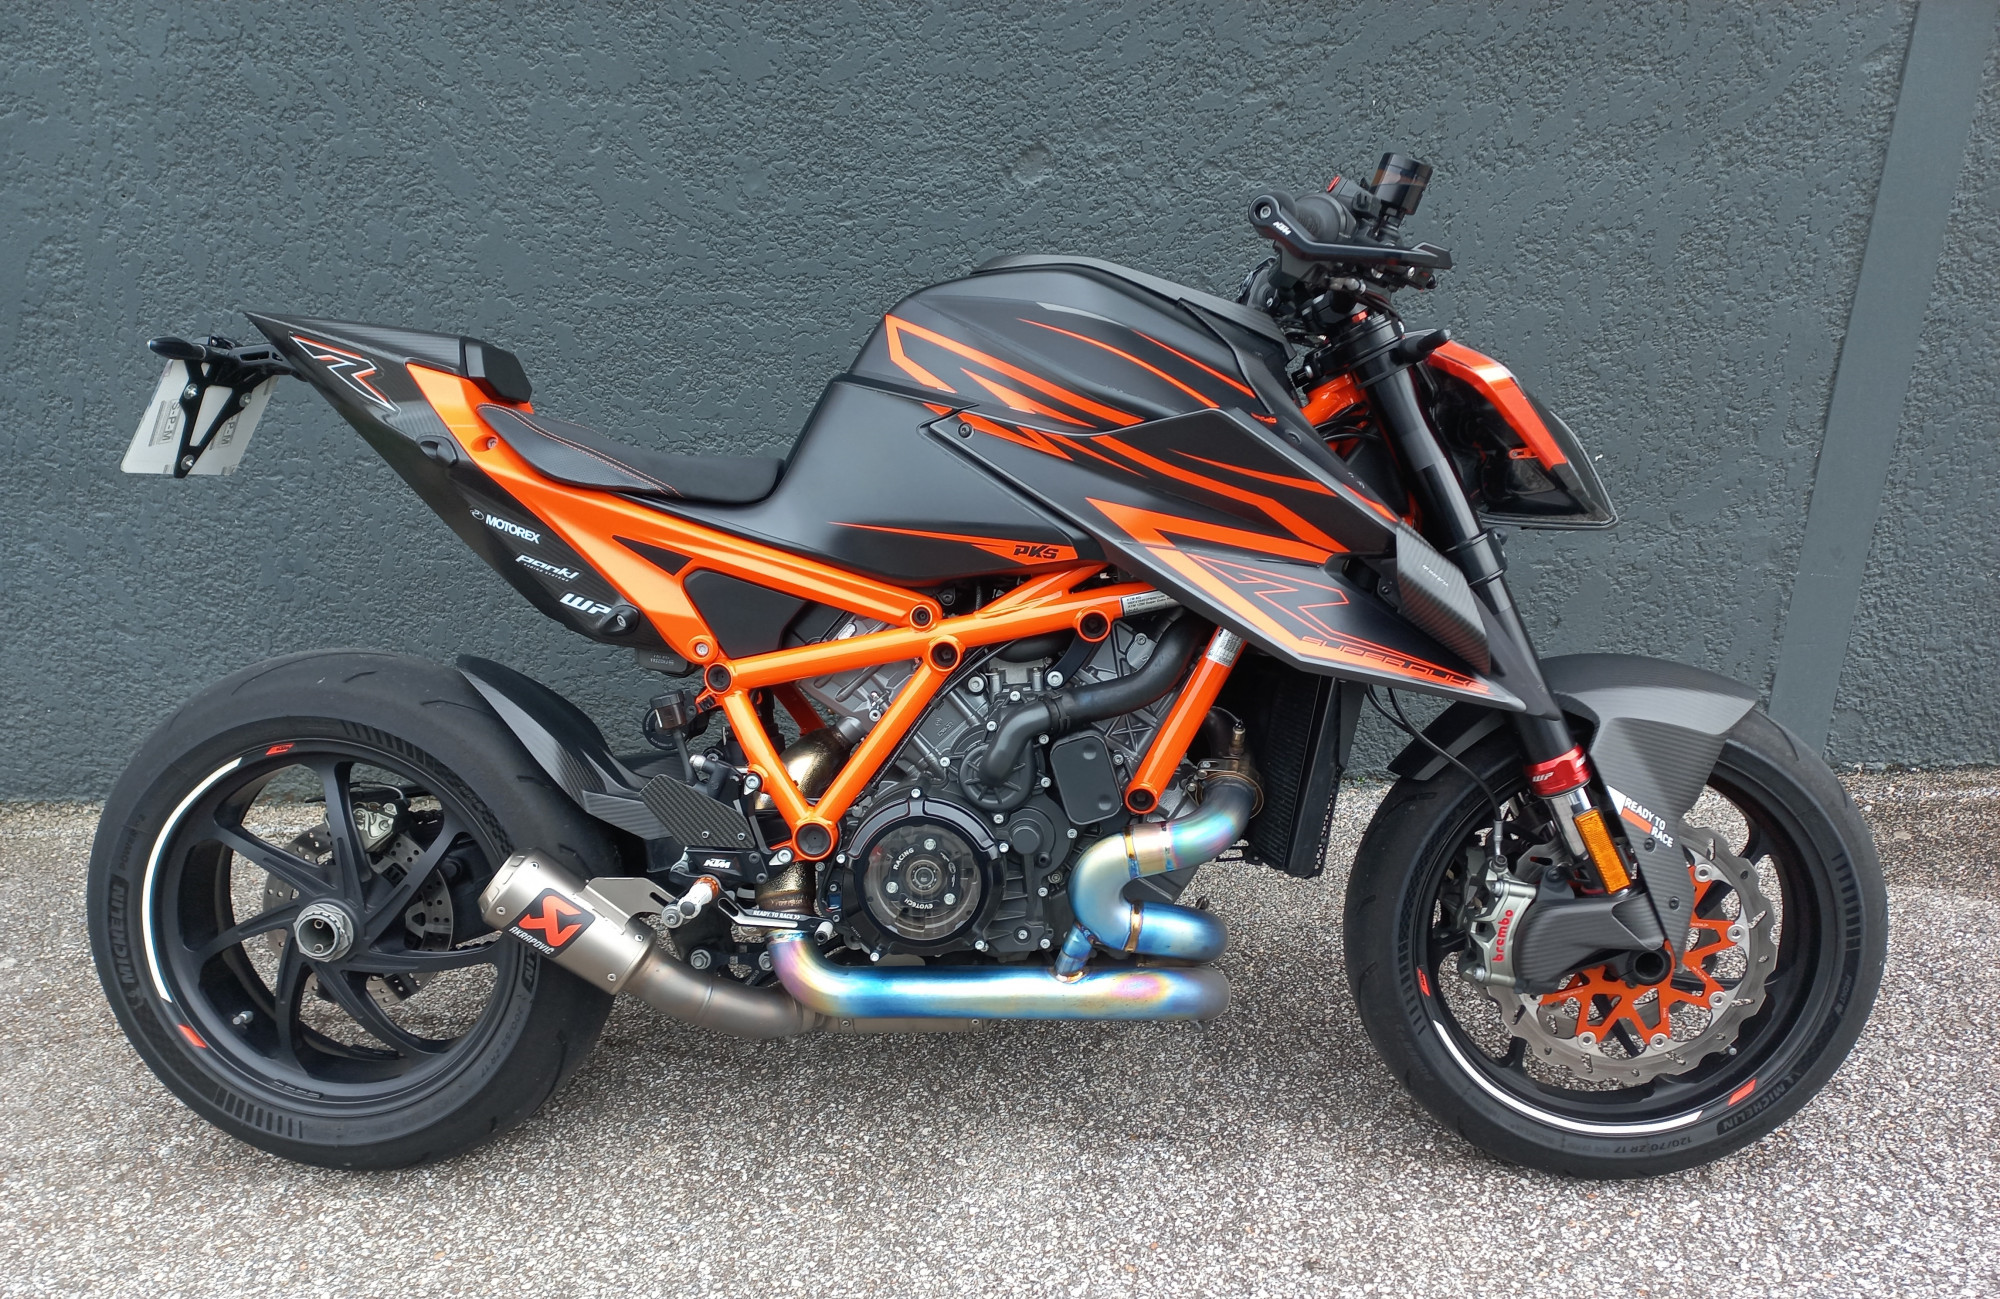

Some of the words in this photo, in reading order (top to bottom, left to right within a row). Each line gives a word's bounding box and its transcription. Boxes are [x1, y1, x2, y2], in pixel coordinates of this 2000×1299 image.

[1272, 220, 1292, 236] KTM
[485, 514, 541, 544] MOTOREX
[1013, 544, 1059, 559] PKS
[559, 592, 612, 615] WP
[1532, 771, 1554, 783] WP
[1624, 796, 1655, 822] READY
[1655, 815, 1667, 830] TO
[1650, 825, 1674, 848] RACE
[703, 857, 731, 869] KTM
[892, 847, 915, 870] RACING
[904, 897, 934, 910] EVOTECH
[753, 909, 771, 918] READY
[779, 912, 793, 920] RACE
[110, 885, 136, 984] MICHELIN
[1492, 909, 1514, 962] brembo
[1723, 1083, 1787, 1131] MICHELIN
[1613, 1146, 1628, 1155] 17
[1629, 1143, 1648, 1154] ZR
[1649, 1135, 1693, 1152] 120/70
